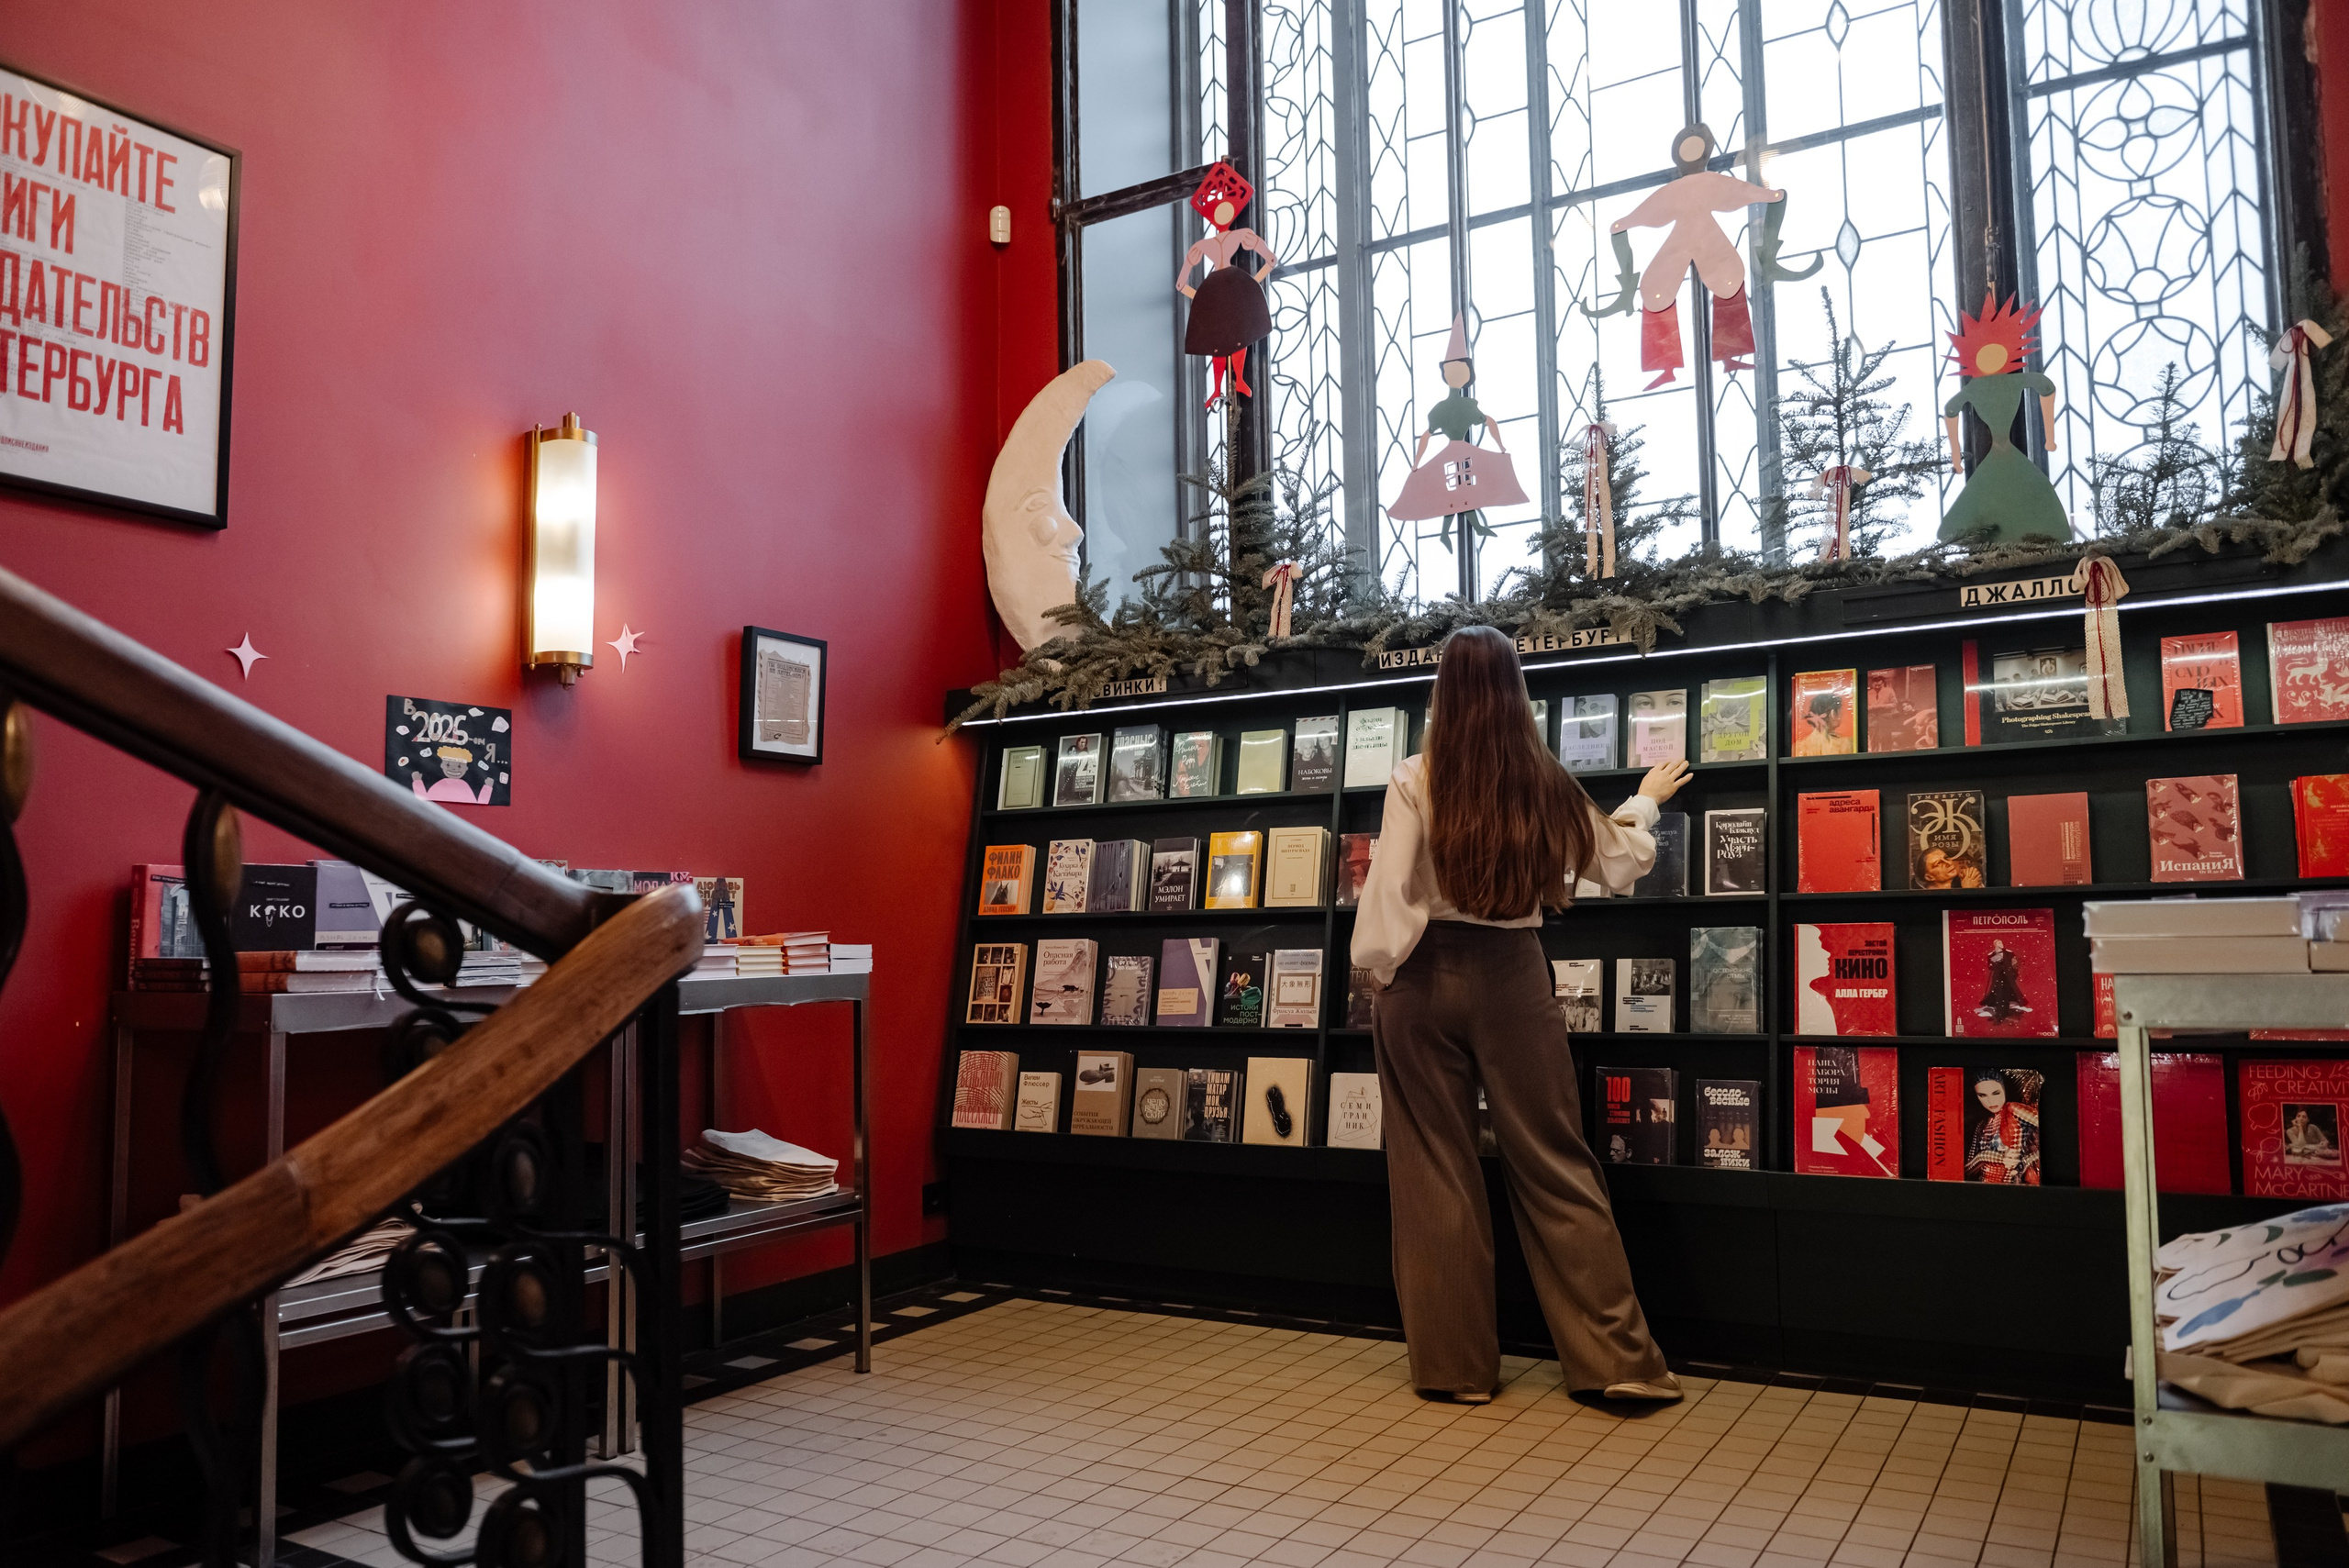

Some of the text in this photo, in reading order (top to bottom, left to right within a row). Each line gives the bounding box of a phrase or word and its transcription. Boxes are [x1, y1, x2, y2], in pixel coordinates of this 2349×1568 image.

[2, 93, 178, 214] КУПАЙТЕ
[2, 172, 75, 255] ИГИ
[0, 248, 210, 368] ДАТЕЛЬСТВ
[1094, 677, 1163, 697] ВИНКИ!
[2001, 714, 2052, 723] Photographing
[1829, 798, 1861, 806] адреса
[1720, 835, 1758, 847] Участь
[988, 851, 1022, 865] ФИЛИН
[986, 865, 1020, 879] ФЛАКО
[1158, 885, 1184, 894] МЭЛОН
[1154, 894, 1186, 903] УМИРАЕТ
[1865, 939, 1887, 947] ЗАСТОЙ
[1043, 959, 1067, 967] работа
[1835, 958, 1888, 979] КИНО
[1835, 989, 1888, 998] АЛЛА ГЕРБЕР
[1808, 1059, 1837, 1067] НАША
[1808, 1068, 1846, 1076] ЛАБОРА
[2249, 1064, 2321, 1079] FEEDING
[1208, 1073, 1230, 1084] ХИШАМ
[1808, 1077, 1840, 1085] ТОРИЯ
[1207, 1084, 1227, 1095] МАТАР
[1606, 1077, 1631, 1102] 100
[1934, 1074, 1945, 1095] ART
[2275, 1080, 2349, 1095] CREATIVI
[1808, 1086, 1838, 1095] МОДЫ
[1206, 1095, 1219, 1106] МОИ
[1341, 1102, 1372, 1110] СЕМИ
[1204, 1106, 1228, 1118] ДРУЗЬЯ
[1934, 1109, 1945, 1166] FASHION
[2254, 1165, 2305, 1181] MARY
